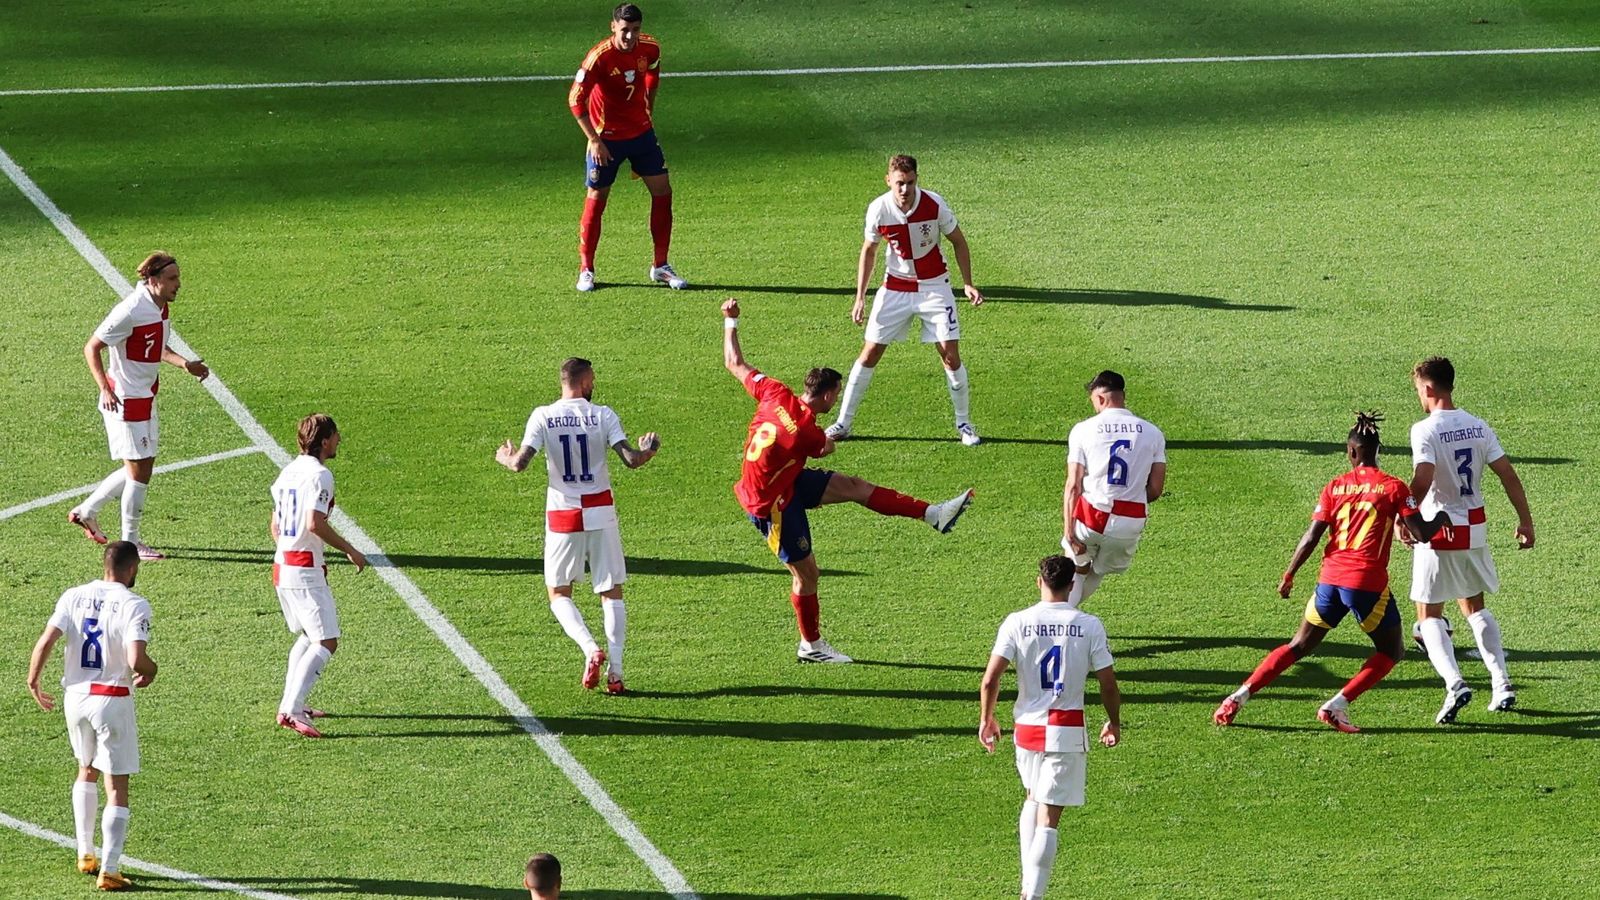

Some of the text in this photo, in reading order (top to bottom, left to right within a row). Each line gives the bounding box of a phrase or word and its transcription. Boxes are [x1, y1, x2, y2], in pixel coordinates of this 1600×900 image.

[625, 84, 635, 101] 7
[890, 239, 905, 257] 2
[945, 305, 957, 325] 2
[144, 339, 155, 359] 7
[558, 433, 594, 483] 11
[745, 421, 777, 462] 8
[1107, 439, 1131, 487] 6
[1454, 447, 1474, 496] 3
[278, 488, 297, 537] 10
[1336, 501, 1377, 550] 17
[81, 617, 103, 670] 8
[1023, 624, 1084, 638] GVARDIOL
[1040, 645, 1064, 692] 4
